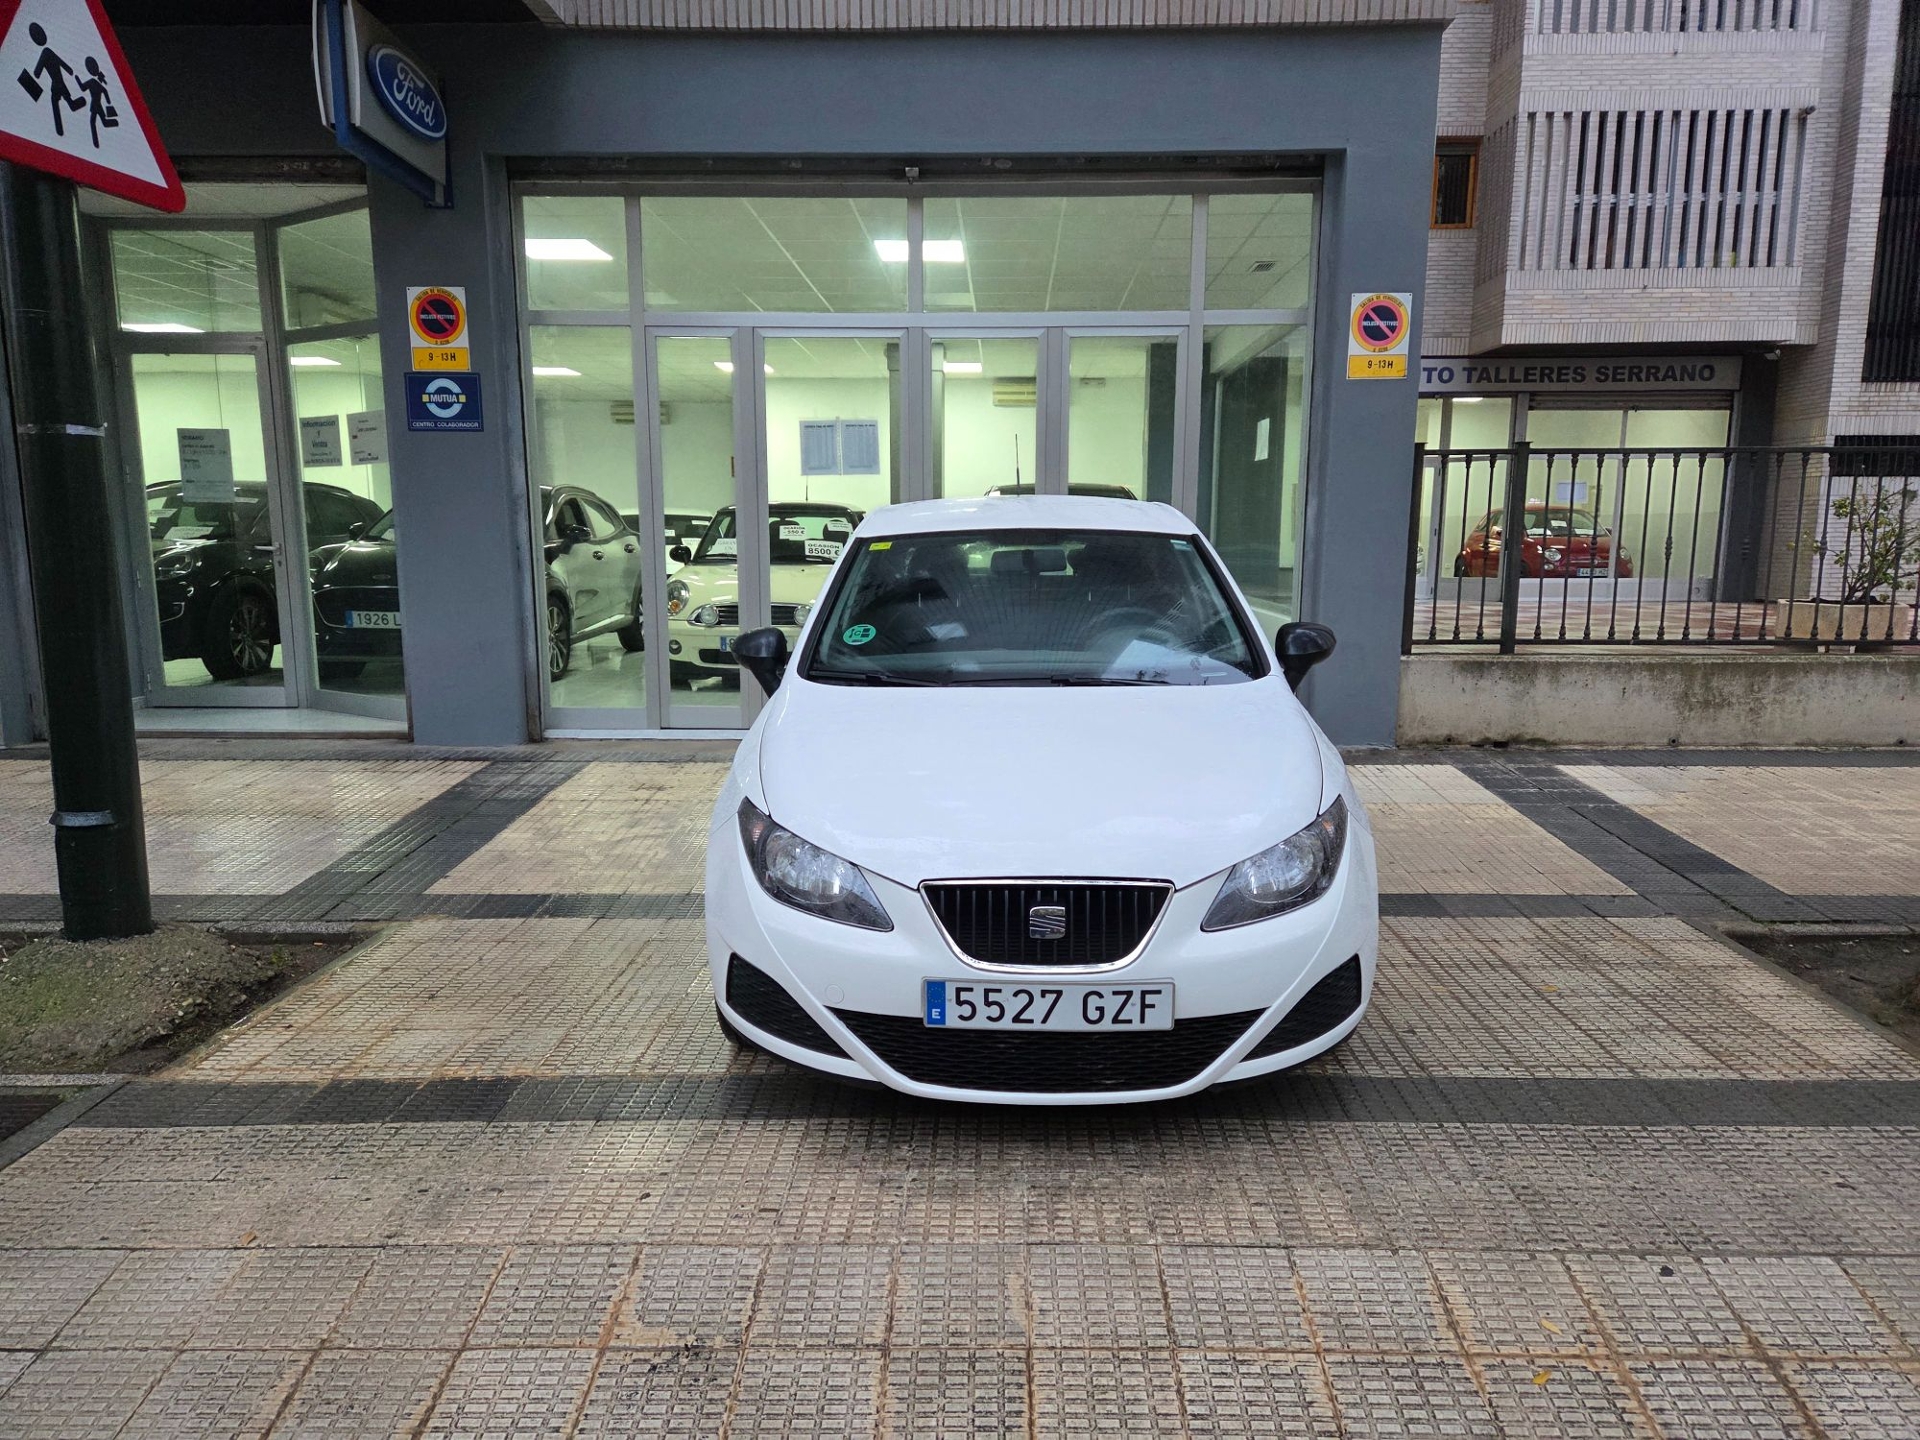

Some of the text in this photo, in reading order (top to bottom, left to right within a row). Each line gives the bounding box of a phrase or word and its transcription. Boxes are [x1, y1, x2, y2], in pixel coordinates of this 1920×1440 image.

[393, 61, 436, 127] Ford
[1463, 365, 1587, 384] TALLERES
[1595, 364, 1716, 383] SERRANO
[430, 394, 458, 403] MUTUA
[808, 547, 832, 556] 8500
[357, 613, 389, 626] 1926
[954, 987, 1163, 1025] 5527 GZF
[931, 1008, 941, 1019] E
